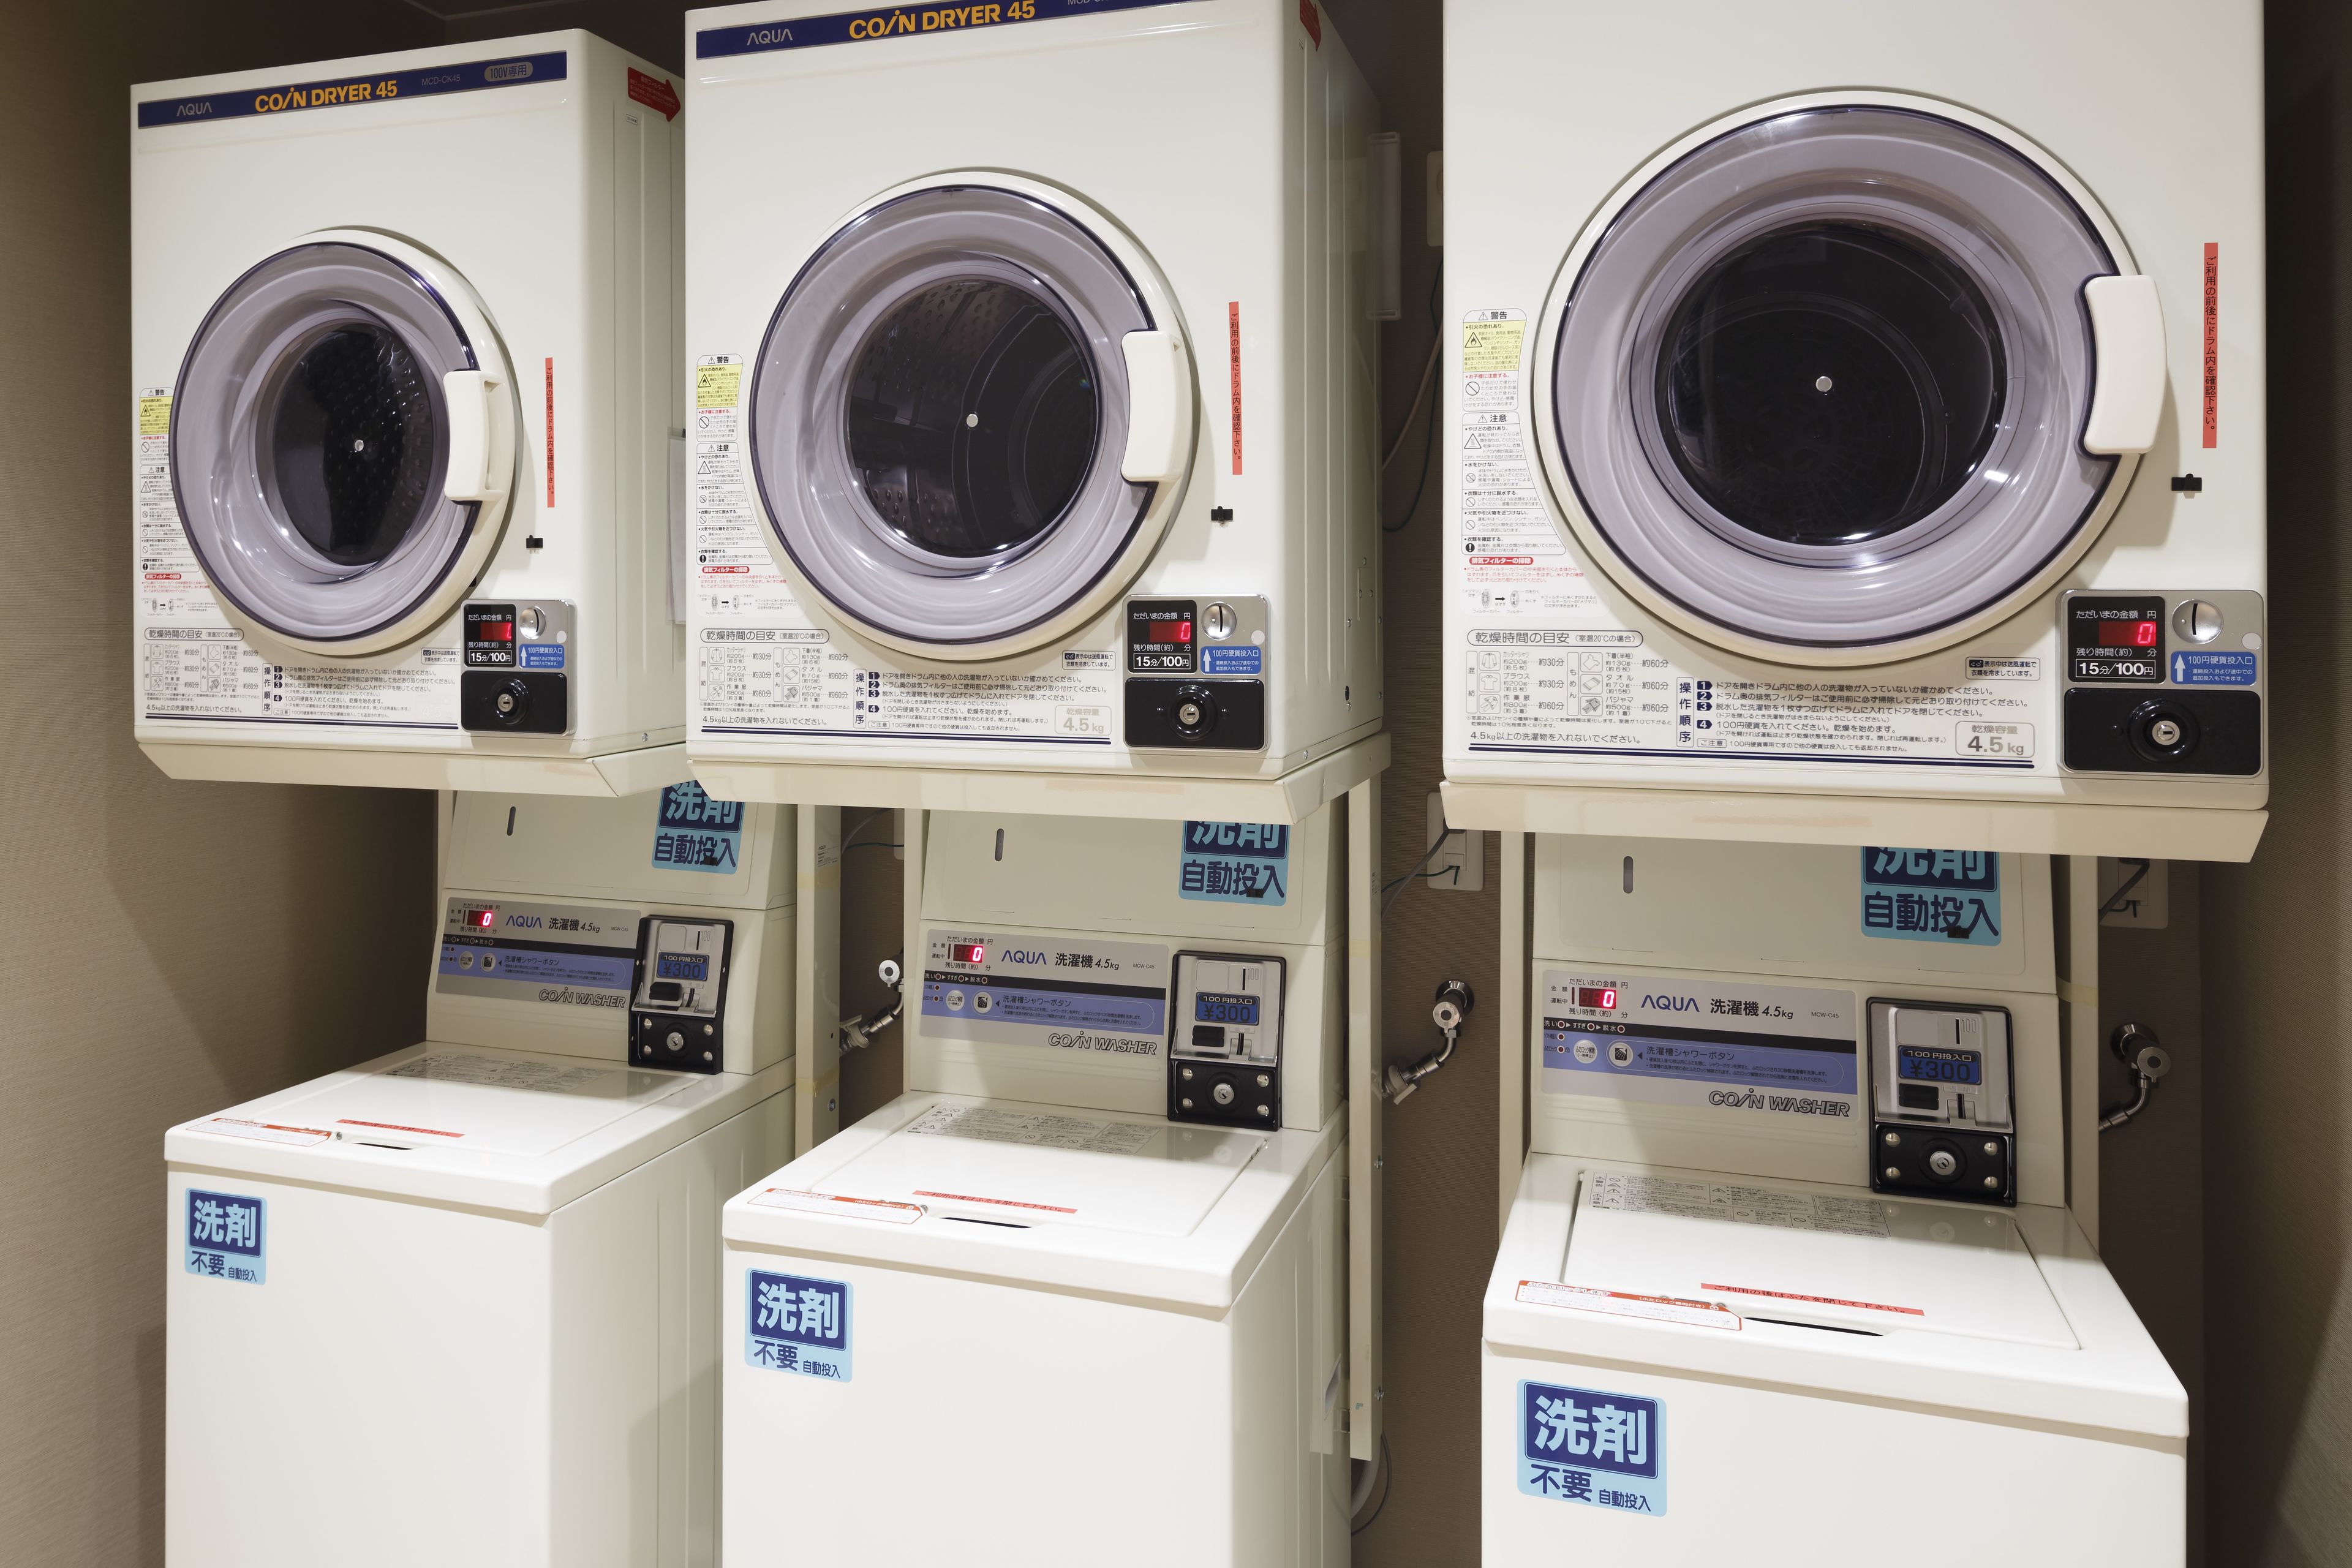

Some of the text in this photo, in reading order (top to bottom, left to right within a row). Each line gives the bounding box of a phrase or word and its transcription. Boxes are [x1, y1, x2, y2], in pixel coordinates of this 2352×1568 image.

[747, 28, 793, 45] AQUA
[922, 4, 1001, 31] DRYER
[1007, 0, 1035, 20] 45
[176, 102, 212, 116] AQUA
[311, 84, 371, 105] DRYER
[376, 80, 398, 97] 45
[421, 74, 461, 86] MCD-CK45
[490, 65, 527, 79] 100V専用
[2205, 256, 2217, 430] ご利用の前後にドラム内を確認下さい。
[1231, 313, 1241, 460] ご利用の前後にドラム内を確認下さい。
[2076, 611, 2156, 619] ただいまの金額 円
[149, 630, 202, 639] 乾燥時間の目安
[706, 631, 775, 641] 乾燥時間の目安
[1181, 622, 1191, 639] 0
[1476, 632, 1569, 644] 乾燥時間の目安
[2137, 624, 2153, 644] 0
[2147, 649, 2157, 657] 分
[1136, 656, 1189, 667] 15分/100円
[1538, 658, 1564, 667] 約30分
[1642, 659, 1669, 668] 約60分
[2079, 663, 2154, 676] 15分/100円
[1538, 680, 1564, 689] 約30分
[1642, 681, 1669, 690] 約60分
[855, 673, 864, 725] 操作順序
[1538, 701, 1564, 710] 約60分
[1642, 703, 1669, 712] 約60分
[1679, 682, 1691, 743] 操作順序
[703, 715, 827, 726] 4.5kg以上の洗濯物を入れないでください。
[1972, 725, 2018, 734] 乾燥容量
[1471, 731, 1640, 745] 4.5kg以上の洗濯物を入れないでください。
[654, 833, 736, 867] 自動投入
[1182, 859, 1285, 898] 自動投入
[483, 913, 492, 926] 0
[1865, 891, 1999, 937] 自動投入
[506, 915, 542, 929] AQUA
[548, 918, 579, 932] 洗濯機
[580, 922, 600, 933] 4.5kg
[973, 947, 982, 961] 0
[1001, 950, 1047, 965] AQUA
[1055, 952, 1093, 968] 洗濯機
[1095, 957, 1120, 971] 4.5kg
[1569, 978, 1616, 988] ただいまの金額
[576, 993, 626, 1008] WASHER
[1003, 995, 1071, 1007] 洗濯槽シャワーボタン
[1603, 991, 1615, 1007] 0
[1641, 994, 1700, 1012] AQUA
[1710, 998, 1759, 1017] 洗濯機
[1762, 1005, 1793, 1019] 4.5kg
[1095, 1037, 1157, 1055] WASHER
[1646, 1046, 1735, 1061] 洗濯槽シャワーボタン
[1769, 1096, 1850, 1117] WASHER
[194, 1199, 256, 1248] 洗剤
[191, 1250, 257, 1282] 不要 自動投入
[1714, 1286, 1905, 1313] ご利用の後はふたを閉じて下さい。
[757, 1281, 839, 1339] 洗剤
[754, 1340, 840, 1378] 不要 自動投入
[1534, 1395, 1647, 1464] 洗剤
[1531, 1464, 1651, 1512] 不要 自動投入
